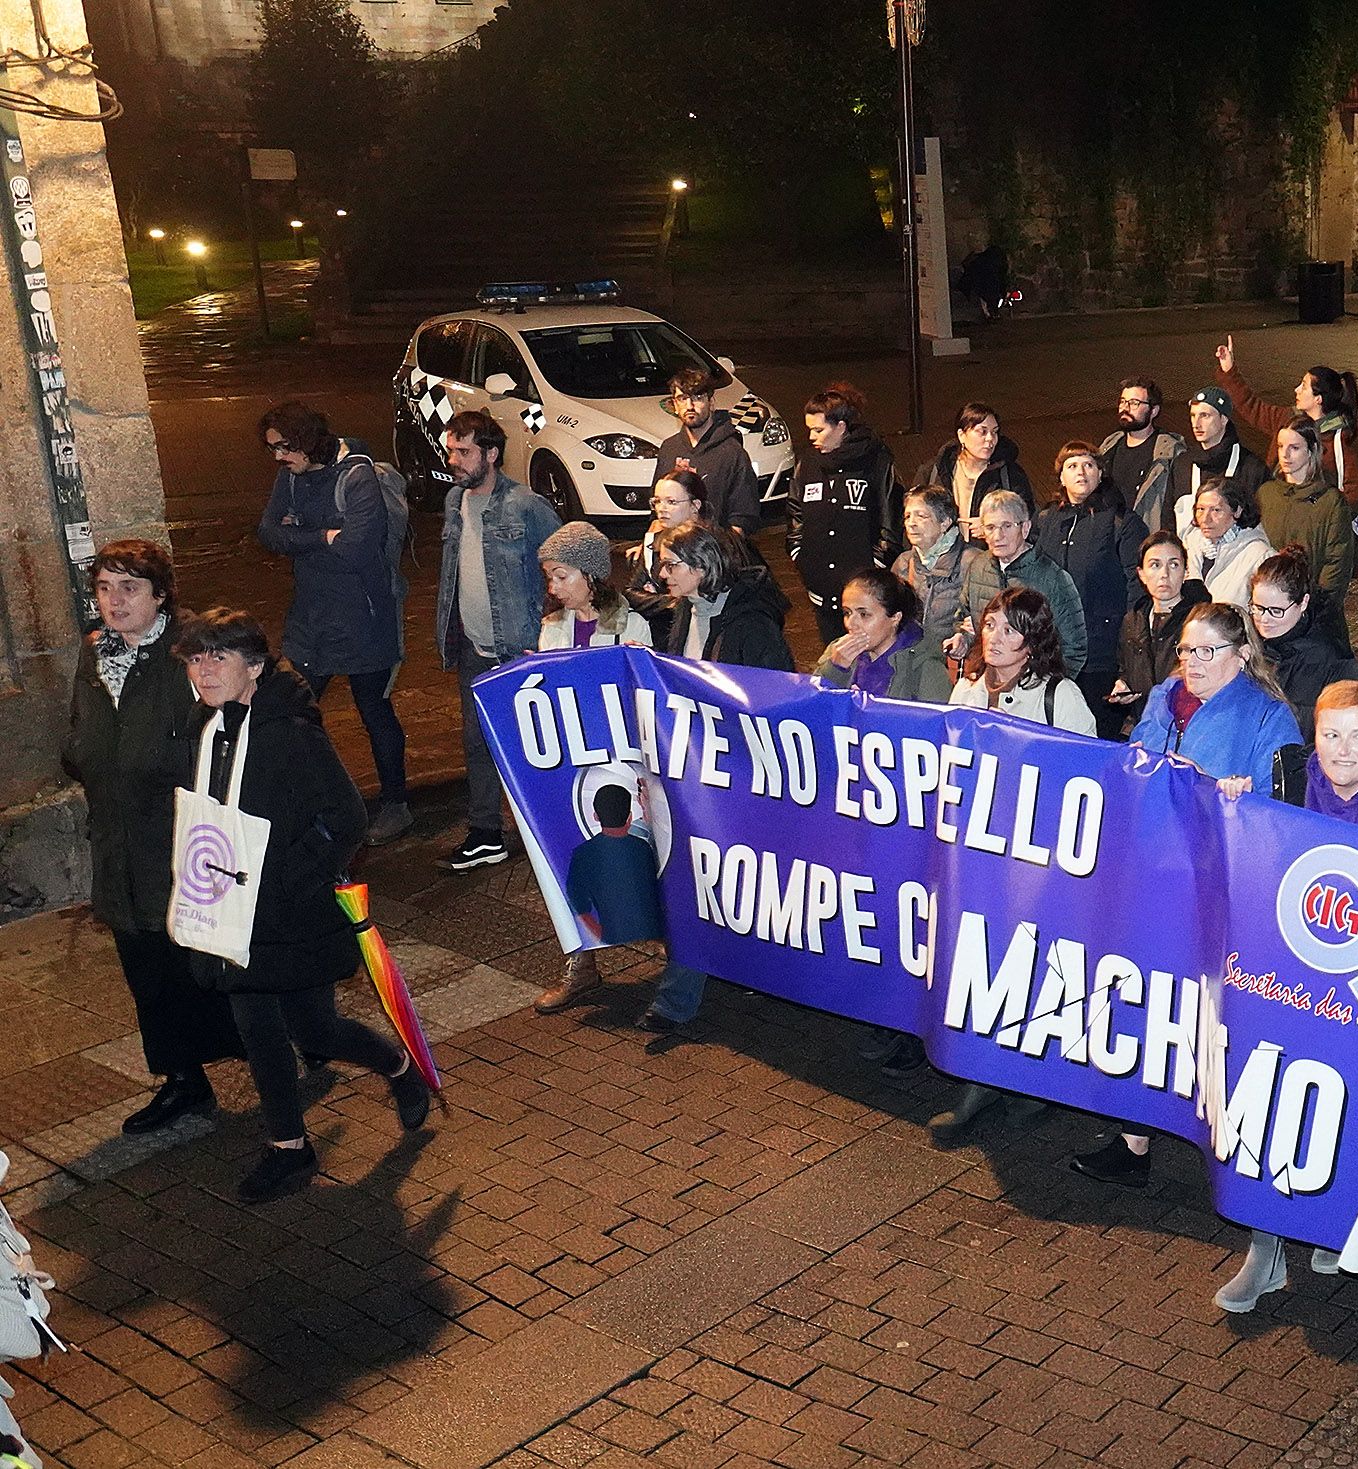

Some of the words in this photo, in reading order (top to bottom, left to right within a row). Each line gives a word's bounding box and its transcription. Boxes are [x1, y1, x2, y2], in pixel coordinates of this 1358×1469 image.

[556, 414, 580, 429] UM-2
[845, 479, 868, 505] V
[514, 673, 732, 788] ÓLLATE
[738, 713, 817, 807] NO
[834, 726, 1105, 878] ESPELLO
[689, 836, 883, 965] ROMPE
[898, 881, 938, 992] C
[944, 911, 1348, 1197] MACHMO
[1313, 986, 1354, 1026] das
